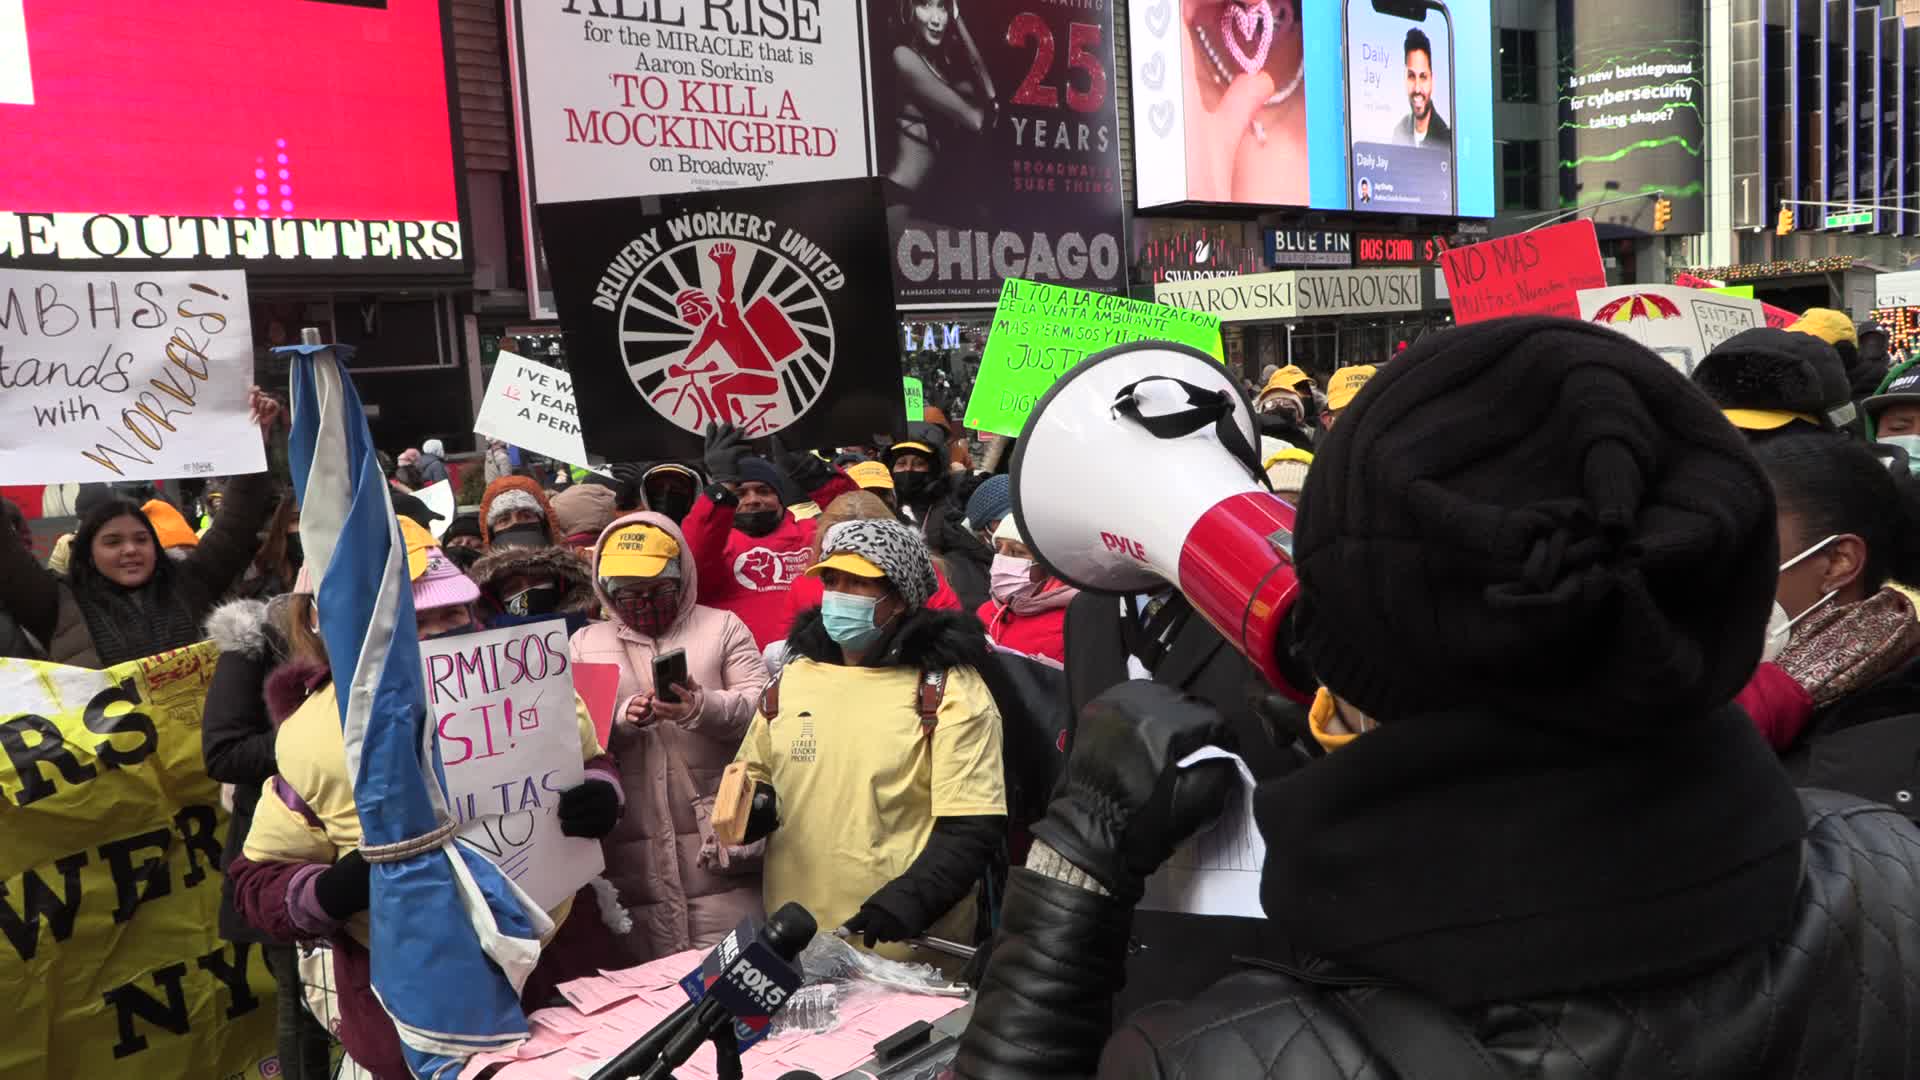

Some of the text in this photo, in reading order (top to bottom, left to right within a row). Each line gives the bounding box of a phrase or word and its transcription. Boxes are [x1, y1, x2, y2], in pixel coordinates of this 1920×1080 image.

[700, 0, 822, 44] RISE
[584, 20, 813, 65] for the MIRACLE that is
[1362, 44, 1390, 70] Daily
[635, 53, 774, 83] Aaron Sorkin's
[1006, 12, 1107, 113] 25
[1588, 70, 1613, 82] new
[1616, 61, 1692, 78] battleground
[1363, 68, 1381, 88] Jay
[679, 80, 768, 118] KILL
[776, 89, 801, 120] A
[1570, 84, 1692, 110] for cybersecurity
[1589, 108, 1674, 128] taking shape?
[1011, 117, 1109, 152] YEARS
[649, 156, 673, 172] on
[1376, 156, 1388, 171] Jay
[82, 214, 458, 258] OUTFITTERS
[1275, 231, 1350, 250] BLUE FIN
[1360, 239, 1383, 260] DOS
[1386, 239, 1433, 261] CAMIS
[592, 211, 845, 312] DELIVERY WORKERS UNITED
[897, 230, 1119, 281] CHICAGO
[1449, 235, 1540, 288] NO MAS
[1157, 275, 1420, 309] SWAROVSKI SWAROVSKI
[999, 299, 1169, 331] DE LA VENTA AMBULANTE
[1057, 290, 1069, 305] A
[1074, 292, 1091, 307] LA
[1096, 295, 1217, 328] CRIMINALIZACION
[995, 320, 1029, 336] MAS
[1035, 324, 1099, 341] PERMISOS
[1104, 328, 1111, 343] Y
[1008, 344, 1092, 370] JUSTI
[517, 367, 574, 396] I'VE W
[33, 395, 99, 427] with
[517, 408, 530, 420] A
[530, 390, 578, 416] YEAR
[620, 533, 646, 542] VENDOR
[1100, 531, 1148, 563] PYLE
[438, 697, 517, 765] SI!
[726, 973, 746, 990] NEW
[104, 942, 264, 1060] NY
